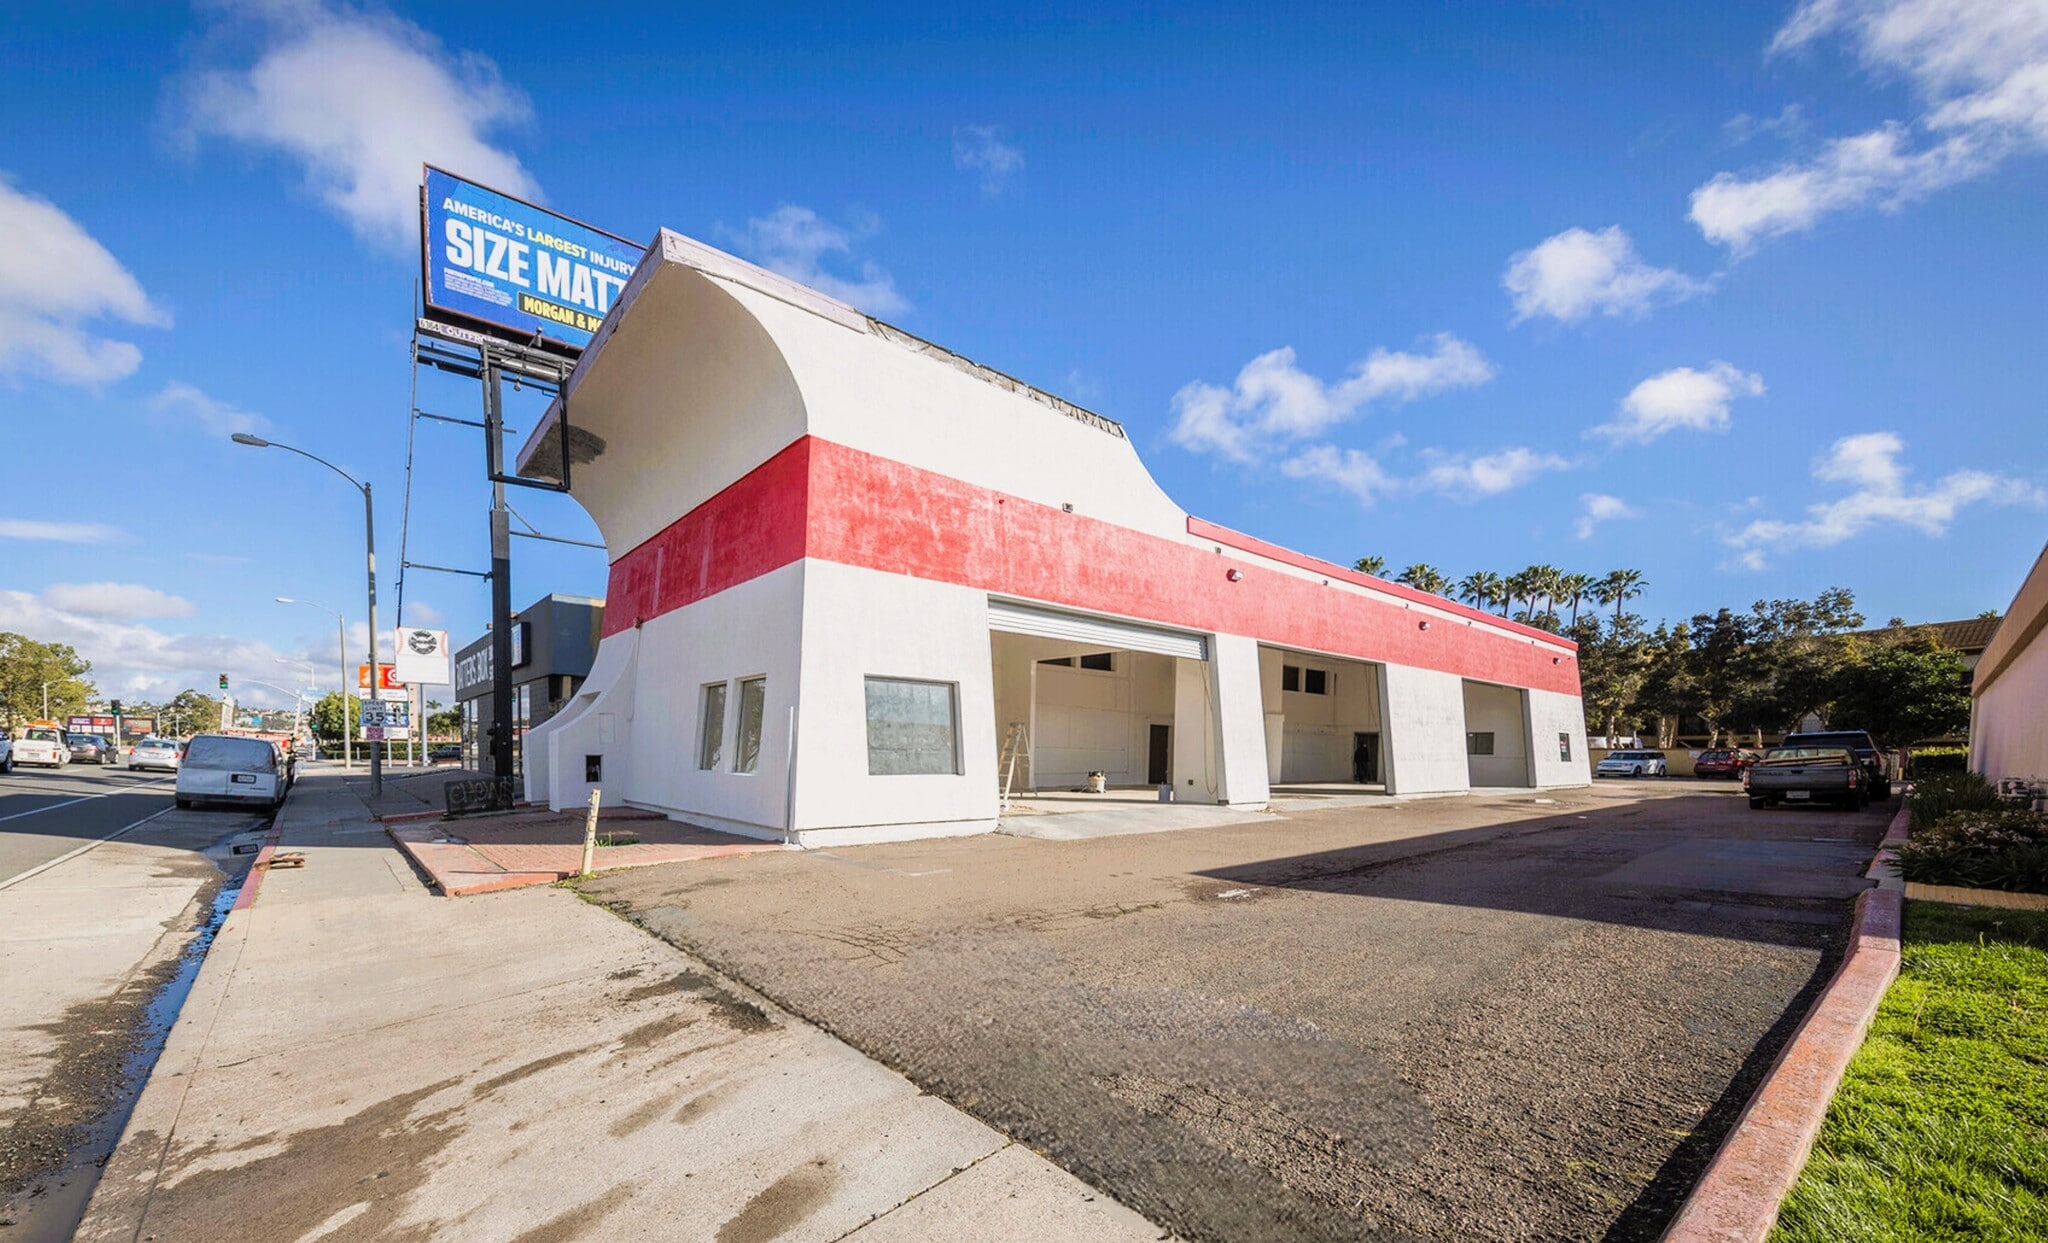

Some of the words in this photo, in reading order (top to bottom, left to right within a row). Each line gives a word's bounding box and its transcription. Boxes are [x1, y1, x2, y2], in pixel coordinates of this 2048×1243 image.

[443, 197, 524, 237] AMERICA'S
[527, 228, 587, 259] LARGEST
[446, 218, 530, 288] SIZE
[524, 296, 574, 325] MORGAN
[576, 314, 586, 329] &
[365, 711, 385, 722] 35
